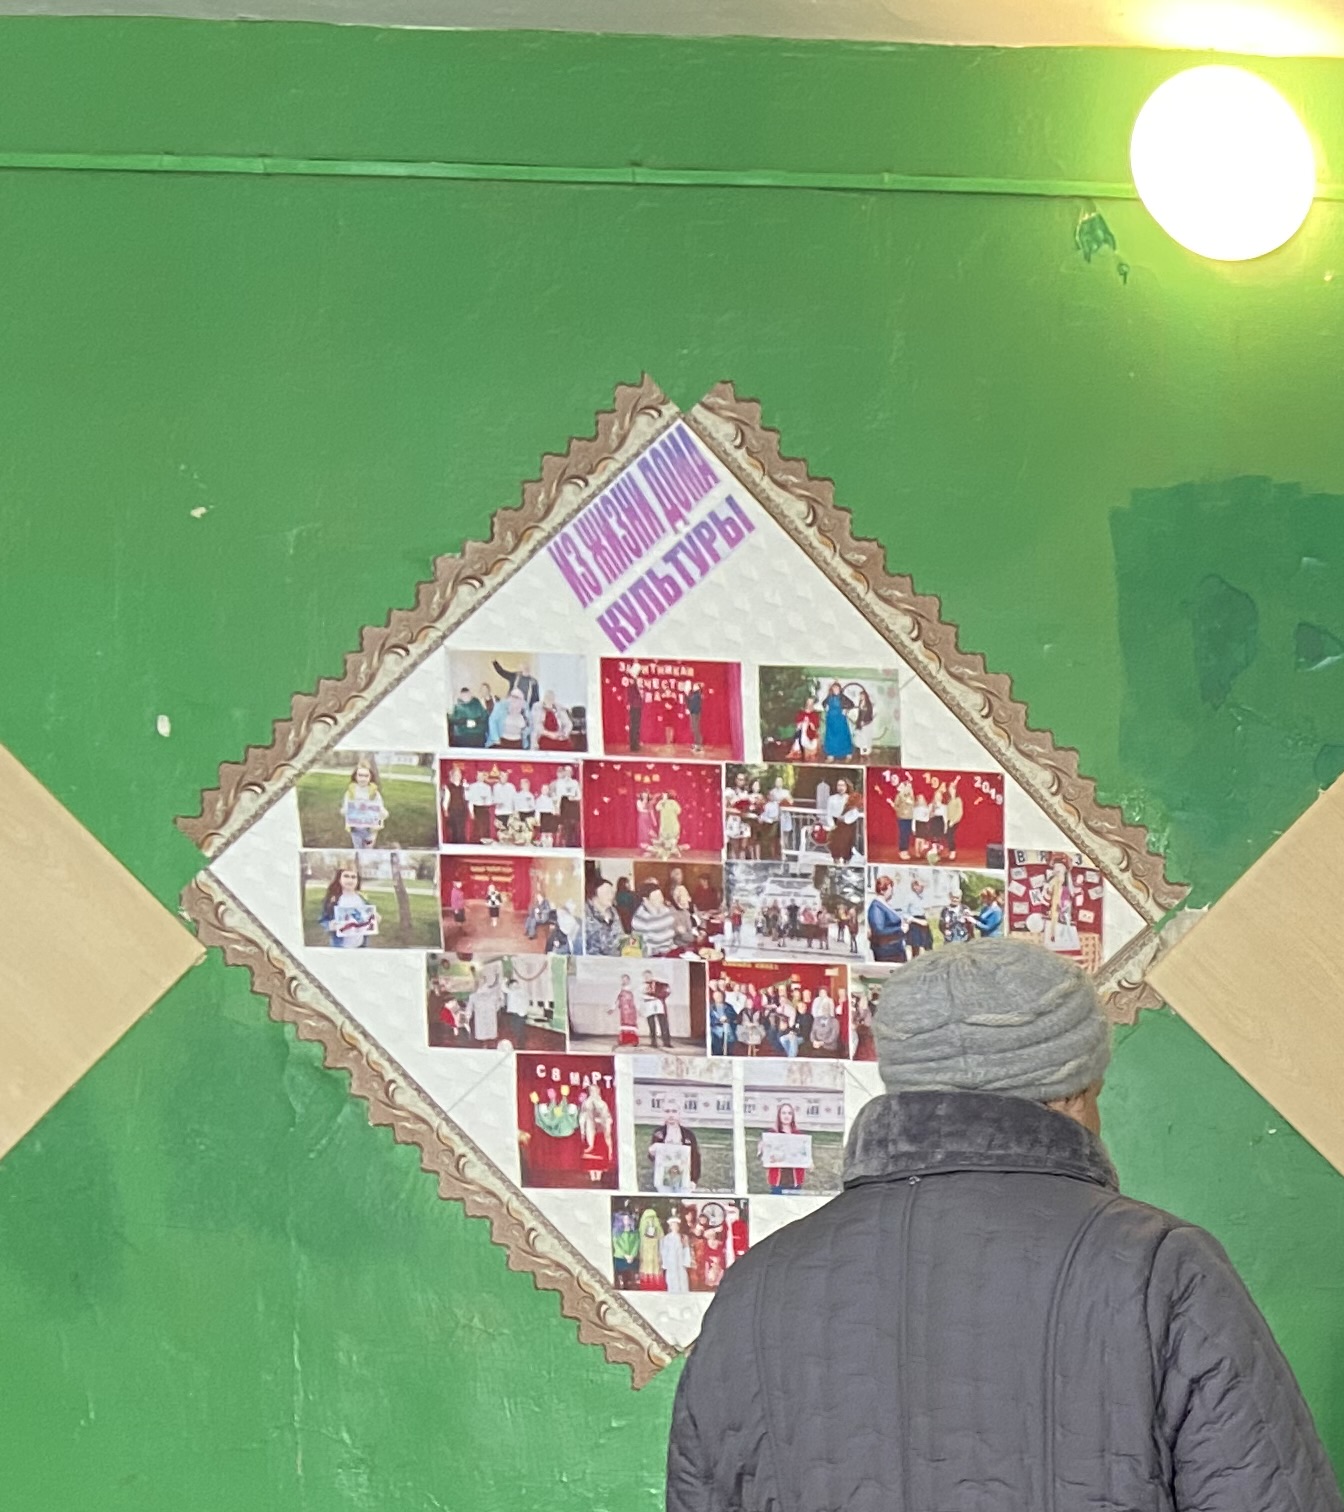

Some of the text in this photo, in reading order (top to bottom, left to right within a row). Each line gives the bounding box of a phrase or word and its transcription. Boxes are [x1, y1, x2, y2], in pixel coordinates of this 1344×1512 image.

[547, 423, 720, 608] ИЗ ЖИЗНИ ДОМА
[596, 494, 756, 653] КУЛЬТУРЫ
[569, 1071, 616, 1090] МАРТ
